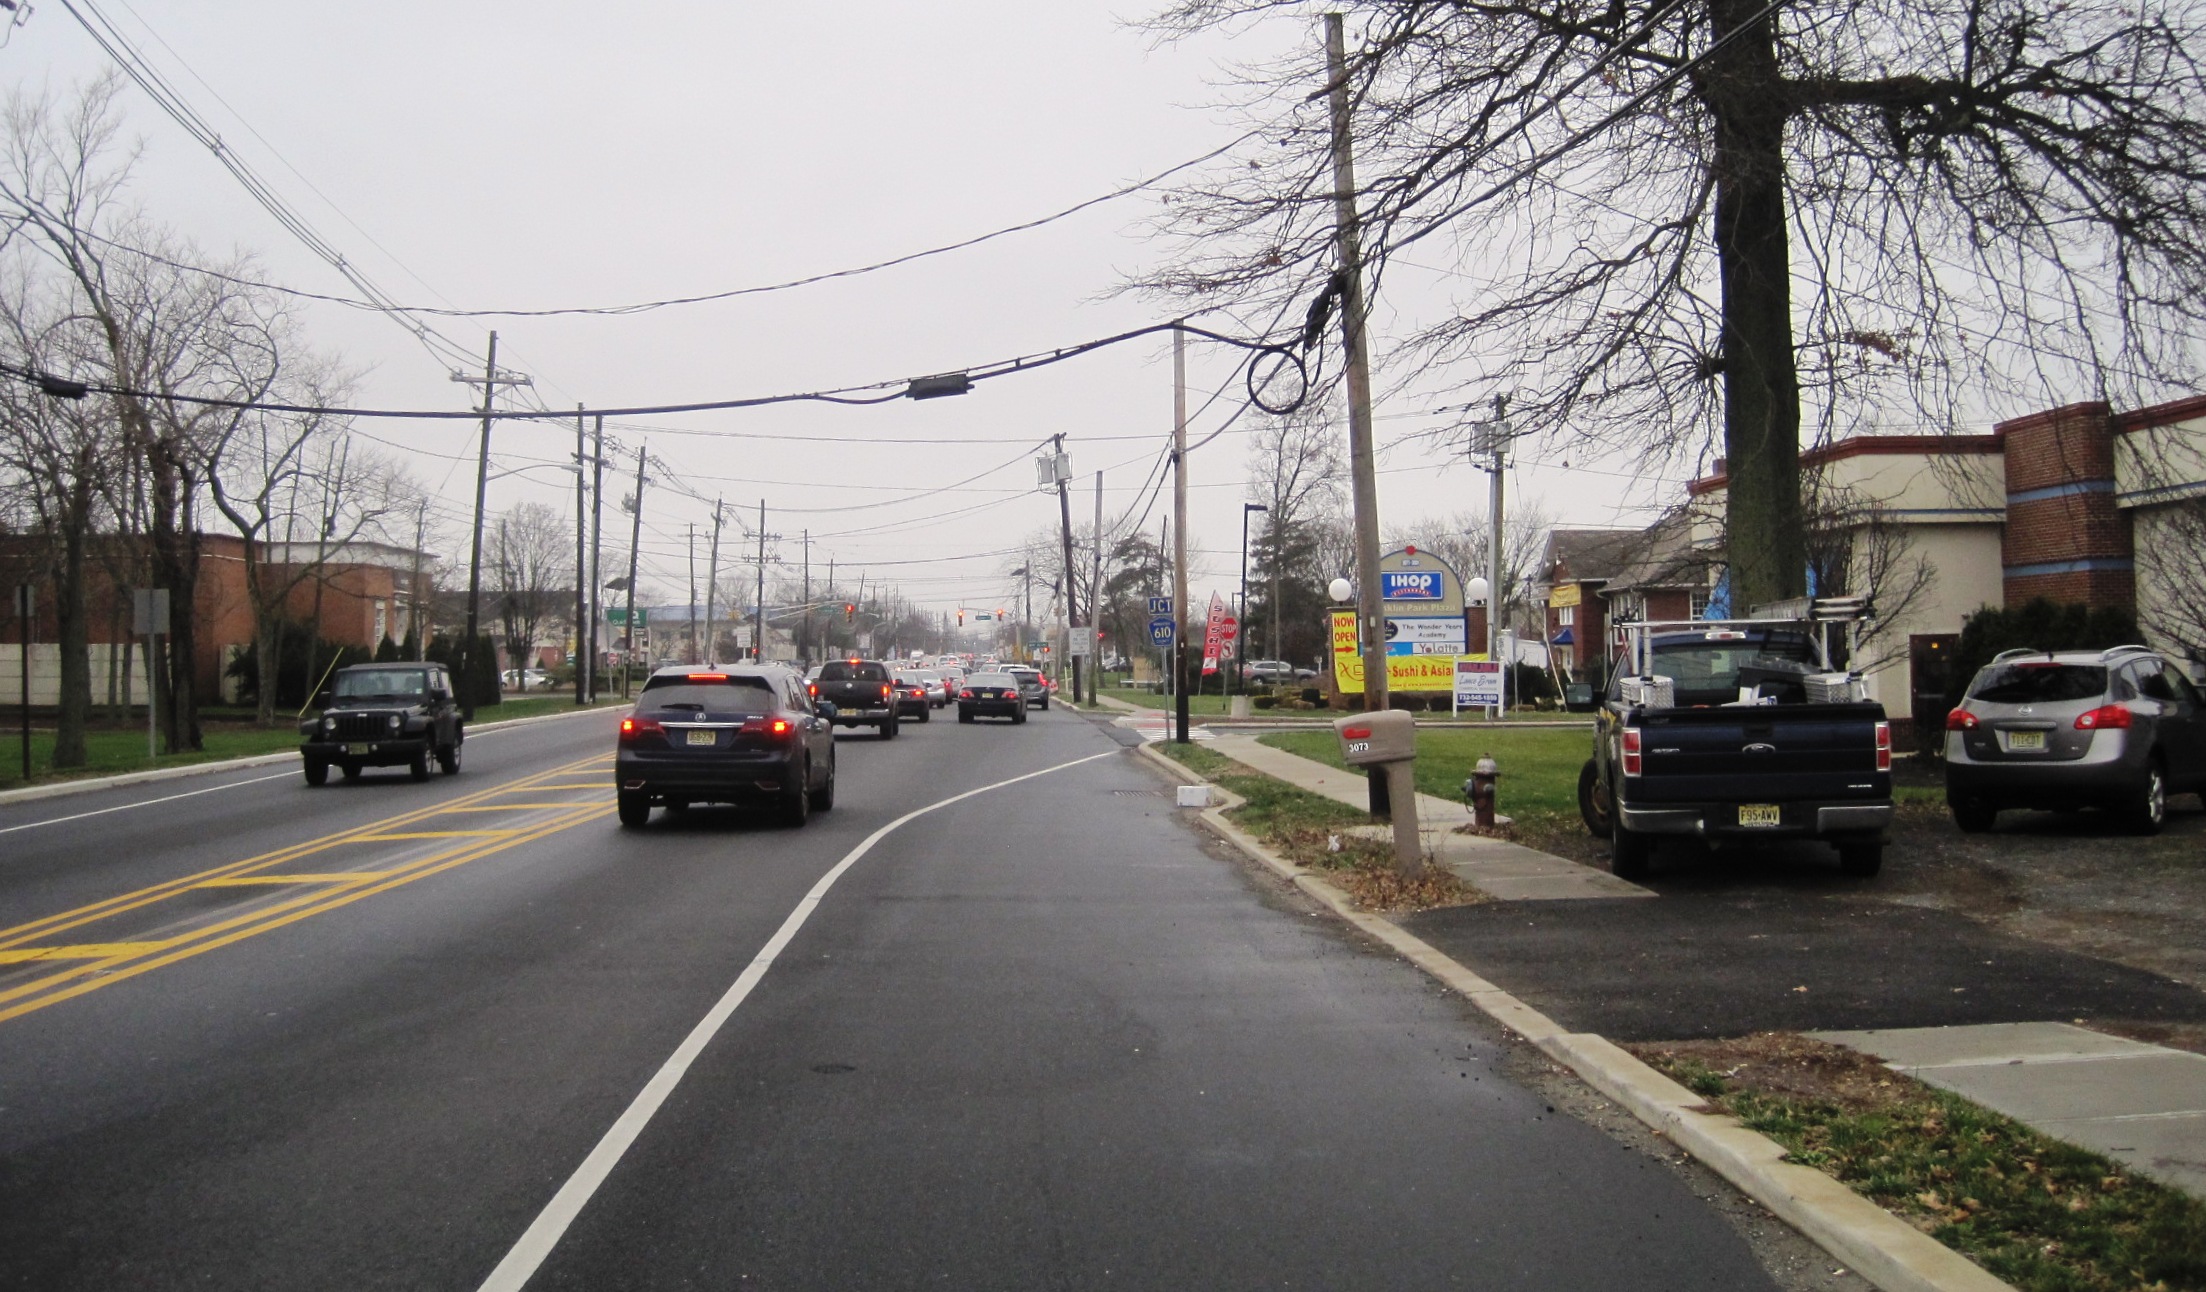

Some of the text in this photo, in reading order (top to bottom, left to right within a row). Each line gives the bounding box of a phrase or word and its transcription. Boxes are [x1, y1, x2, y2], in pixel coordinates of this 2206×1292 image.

[1391, 574, 1432, 590] IHOP
[1150, 599, 1172, 612] JCT
[1407, 603, 1428, 612] Park
[1431, 603, 1456, 612] Plaza
[1334, 617, 1355, 627] NOW
[1154, 627, 1171, 638] 610
[1208, 605, 1223, 655] SUSHI
[1221, 624, 1237, 633] STOP
[1334, 632, 1356, 642] OPEN
[1392, 665, 1419, 678] Sushi
[1421, 664, 1428, 676] &
[1348, 742, 1369, 753] 3073
